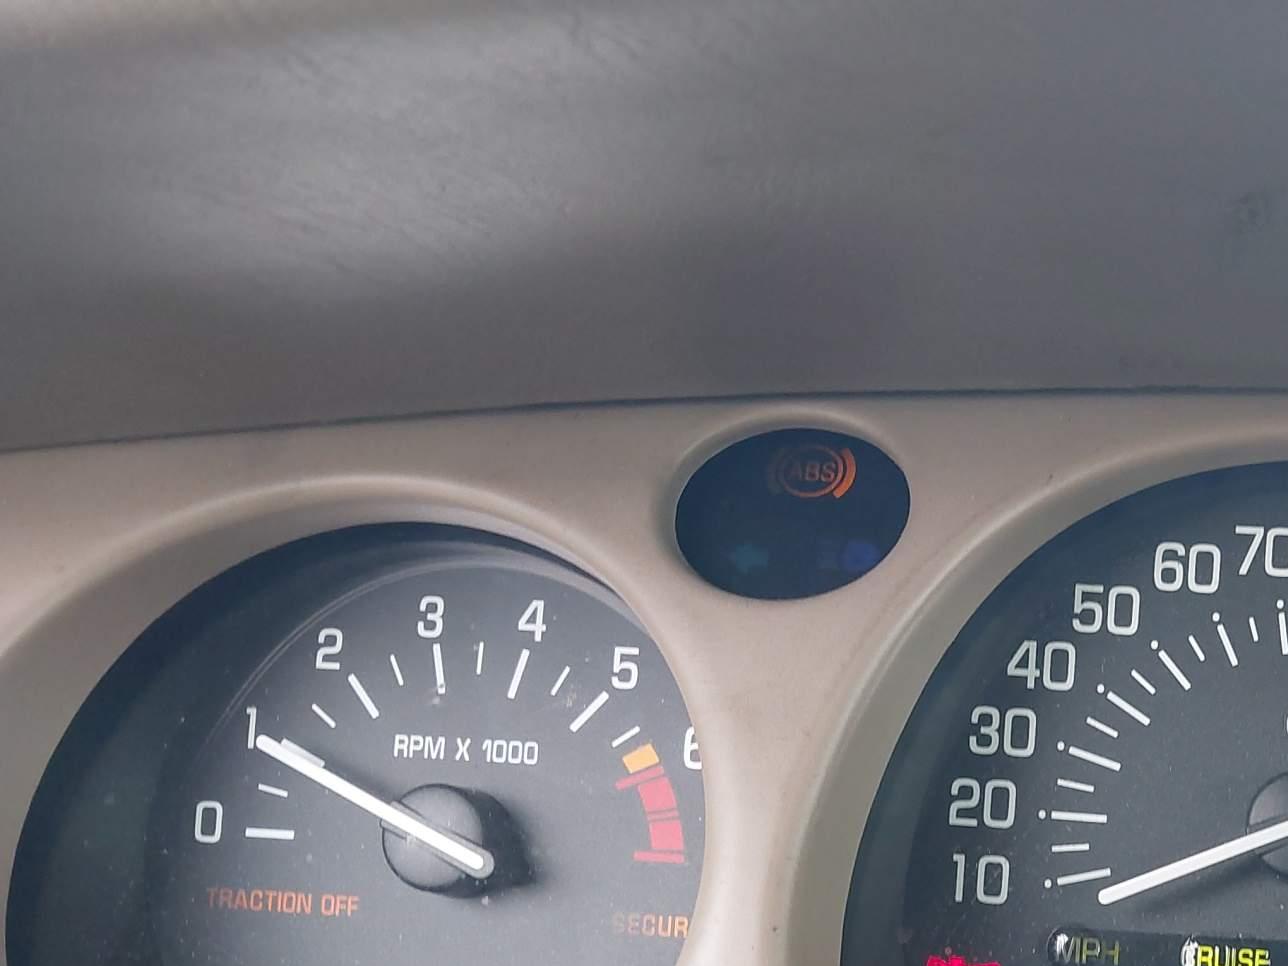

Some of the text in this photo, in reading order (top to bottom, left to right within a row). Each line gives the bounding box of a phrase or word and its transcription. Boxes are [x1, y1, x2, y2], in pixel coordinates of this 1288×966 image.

[787, 461, 836, 483] ABS
[1153, 541, 1222, 595] 60
[418, 596, 444, 639] 3
[519, 600, 546, 642] 4
[1072, 583, 1141, 636] 50
[316, 629, 342, 671] 2
[612, 647, 638, 690] 5
[1007, 640, 1076, 691] 40
[245, 707, 258, 749] 1
[393, 733, 539, 766] RPM X 1000
[968, 705, 1037, 758] 30
[194, 800, 223, 844] 0
[948, 777, 1017, 829] 20
[952, 853, 1010, 905] 10
[207, 888, 359, 917] TRACTION OFF
